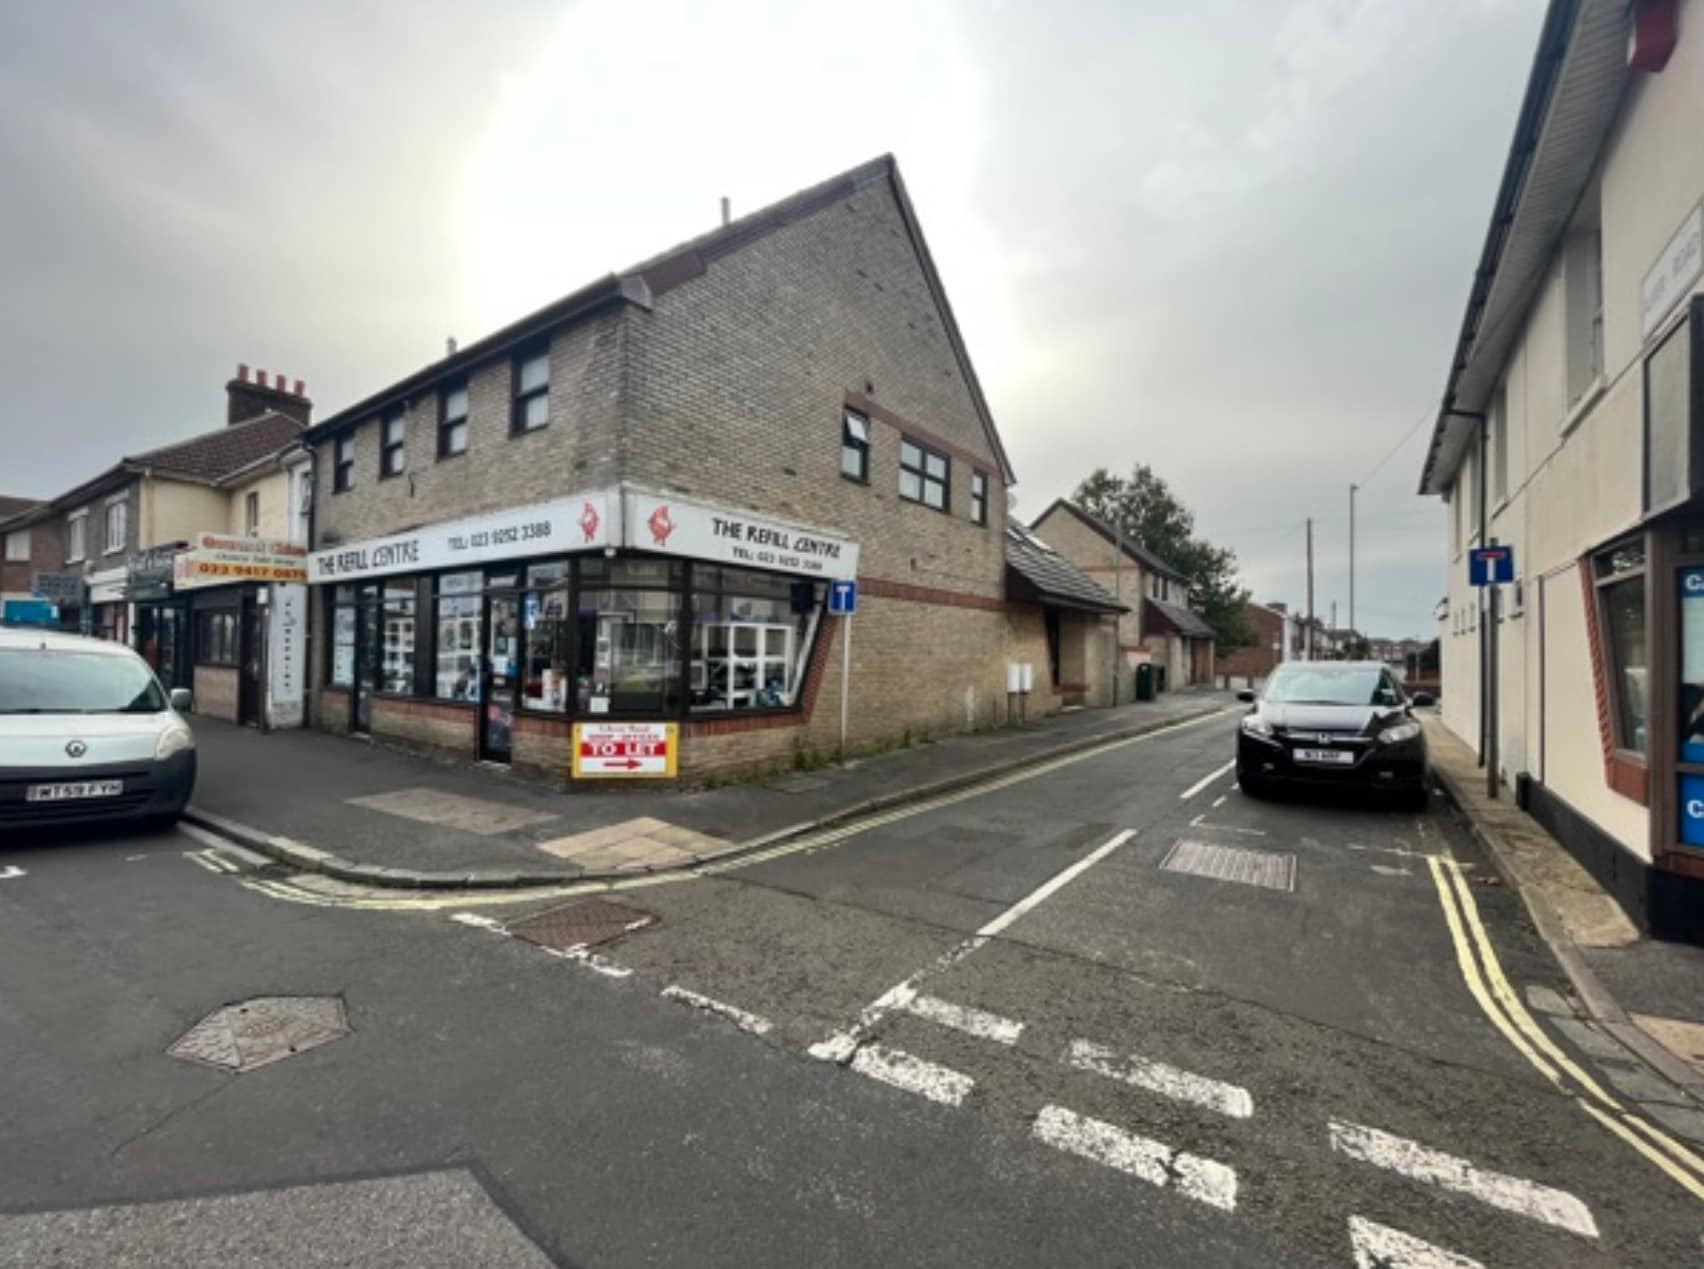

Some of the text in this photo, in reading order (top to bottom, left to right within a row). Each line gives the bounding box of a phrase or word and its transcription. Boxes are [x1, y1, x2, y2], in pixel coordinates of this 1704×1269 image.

[712, 518, 841, 558] THE REFILL CENTRE
[317, 540, 419, 575] THE REFILL CENTRE
[590, 742, 657, 757] TO LET
